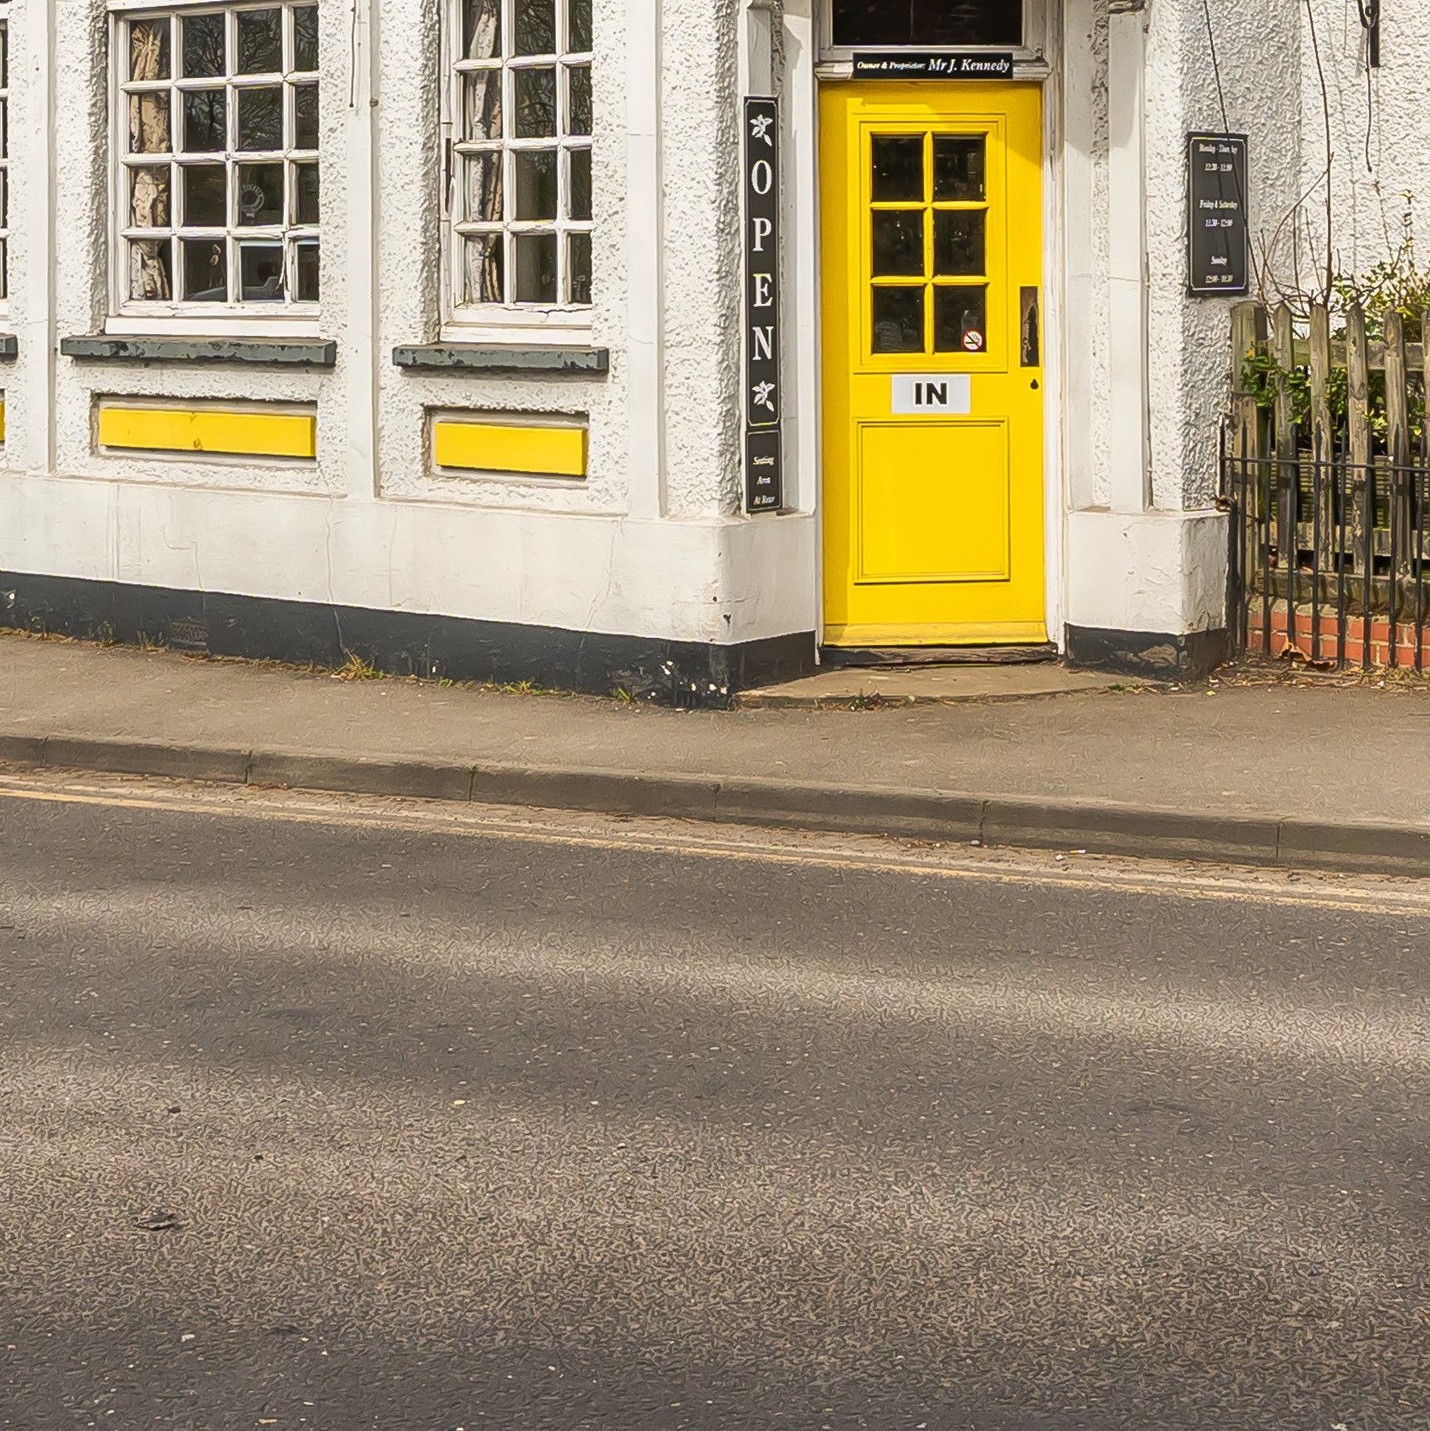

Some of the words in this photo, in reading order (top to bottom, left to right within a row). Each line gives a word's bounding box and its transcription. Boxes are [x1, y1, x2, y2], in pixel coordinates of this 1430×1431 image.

[928, 58, 947, 71] Mr
[947, 59, 958, 73] J.
[960, 58, 1010, 73] Kennedy
[751, 159, 774, 362] OPEN
[914, 383, 947, 406] IN
